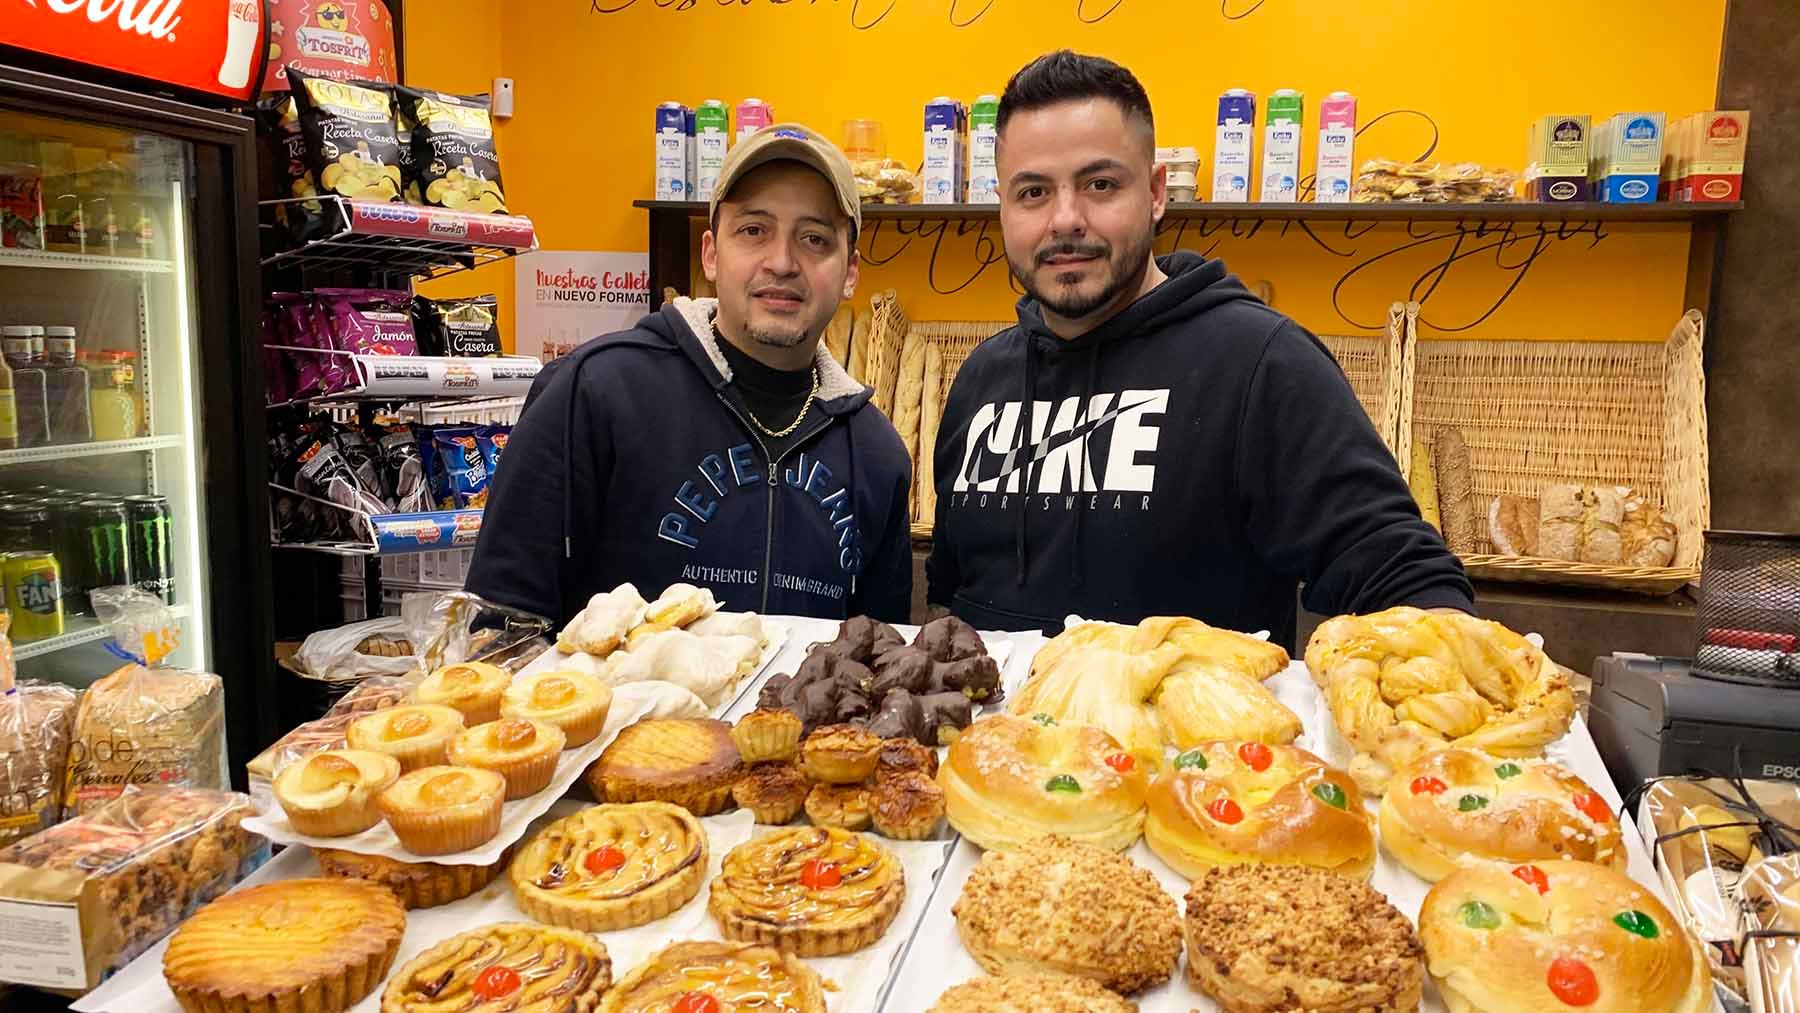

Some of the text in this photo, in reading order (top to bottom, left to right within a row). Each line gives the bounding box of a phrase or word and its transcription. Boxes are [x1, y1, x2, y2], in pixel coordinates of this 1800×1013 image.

[308, 38, 367, 60] TOSFRIT
[323, 123, 399, 146] Receta Casera
[432, 141, 467, 157] Receta
[469, 142, 498, 161] Casera
[536, 268, 597, 289] Nuestras
[554, 290, 596, 302] NUEVO
[372, 325, 415, 342] Jamón
[454, 335, 496, 352] Casera
[658, 443, 761, 549] PEPE
[681, 563, 758, 584] AUTHENTIC
